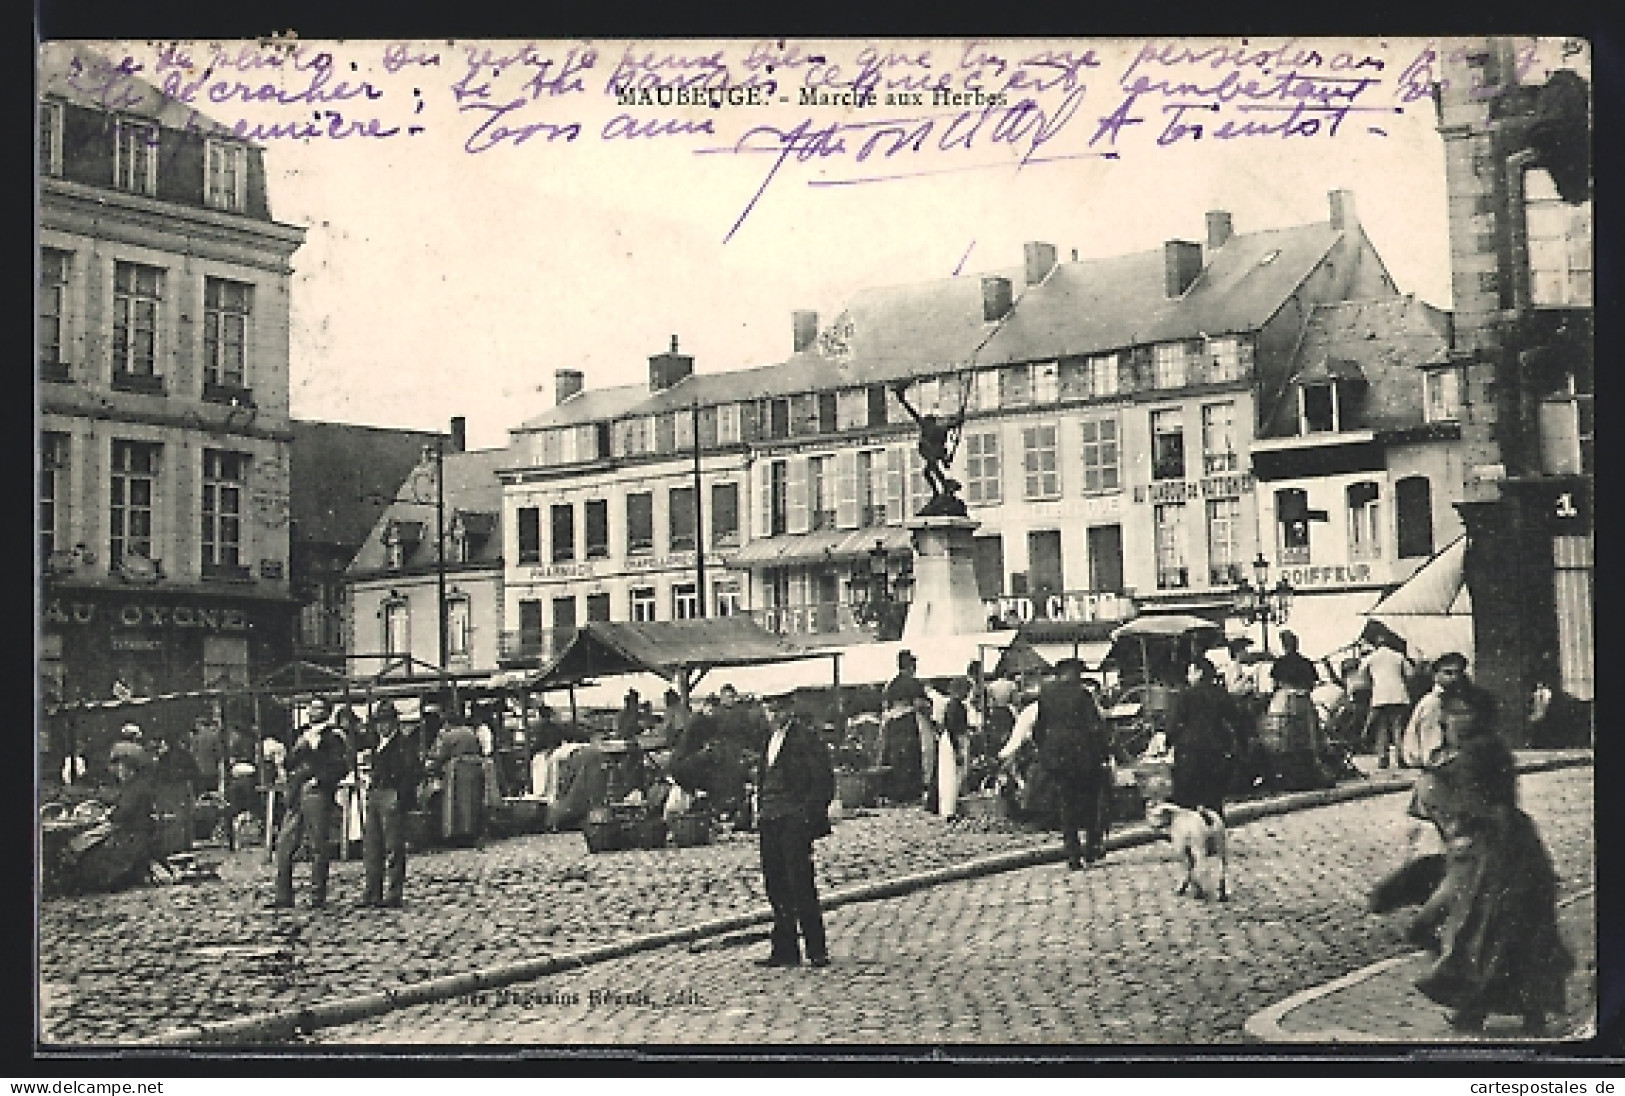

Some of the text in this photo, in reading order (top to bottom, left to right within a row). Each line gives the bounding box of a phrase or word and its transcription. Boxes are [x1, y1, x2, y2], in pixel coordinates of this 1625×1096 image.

[616, 87, 770, 108] MAUBEUGE.
[884, 92, 924, 107] aux
[931, 87, 1008, 107] Herbes
[1556, 492, 1578, 518] 1
